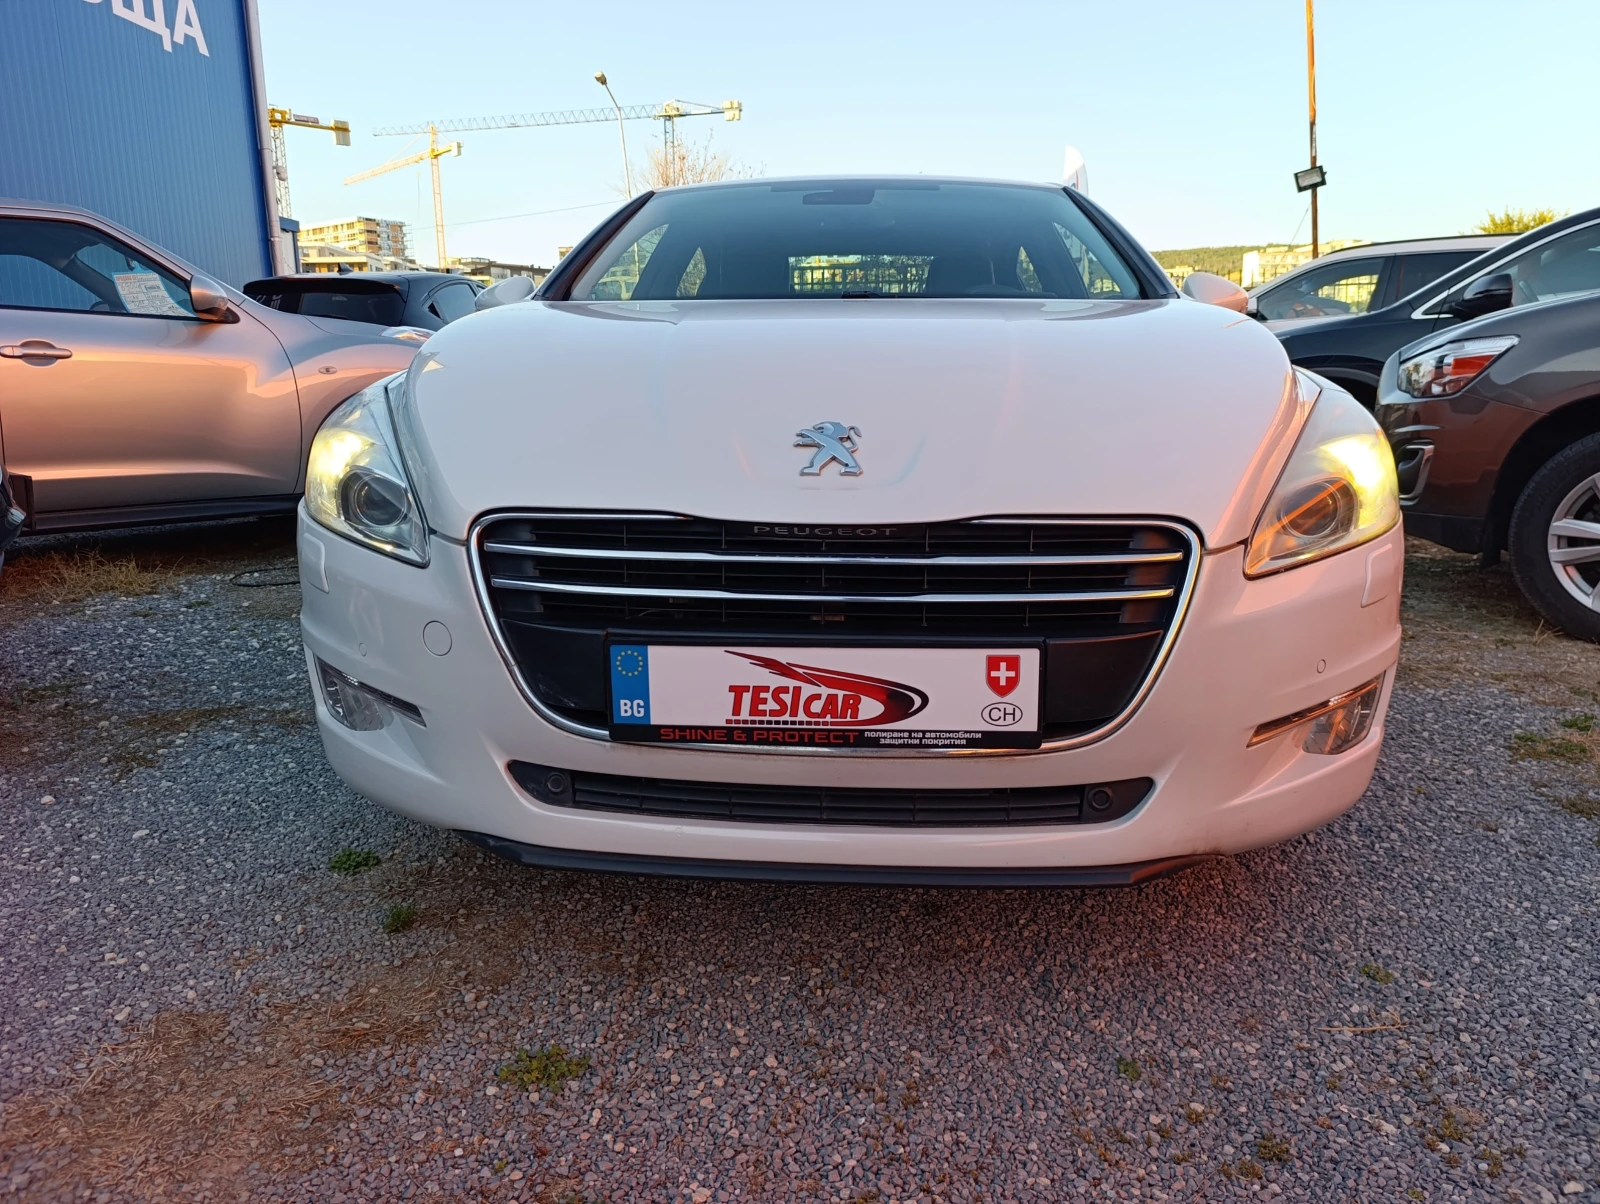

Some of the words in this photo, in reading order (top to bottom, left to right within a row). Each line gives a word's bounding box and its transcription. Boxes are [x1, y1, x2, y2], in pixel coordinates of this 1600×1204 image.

[83, 0, 209, 57] ЩА
[753, 525, 897, 536] PEUGEOT
[620, 699, 645, 718] BG
[988, 707, 1016, 722] CH
[660, 728, 728, 741] SHINE
[733, 730, 747, 741] &
[753, 730, 859, 743] PROTECT
[864, 731, 909, 739] полиране
[924, 731, 982, 739] автомобили
[921, 738, 967, 746] покрития
